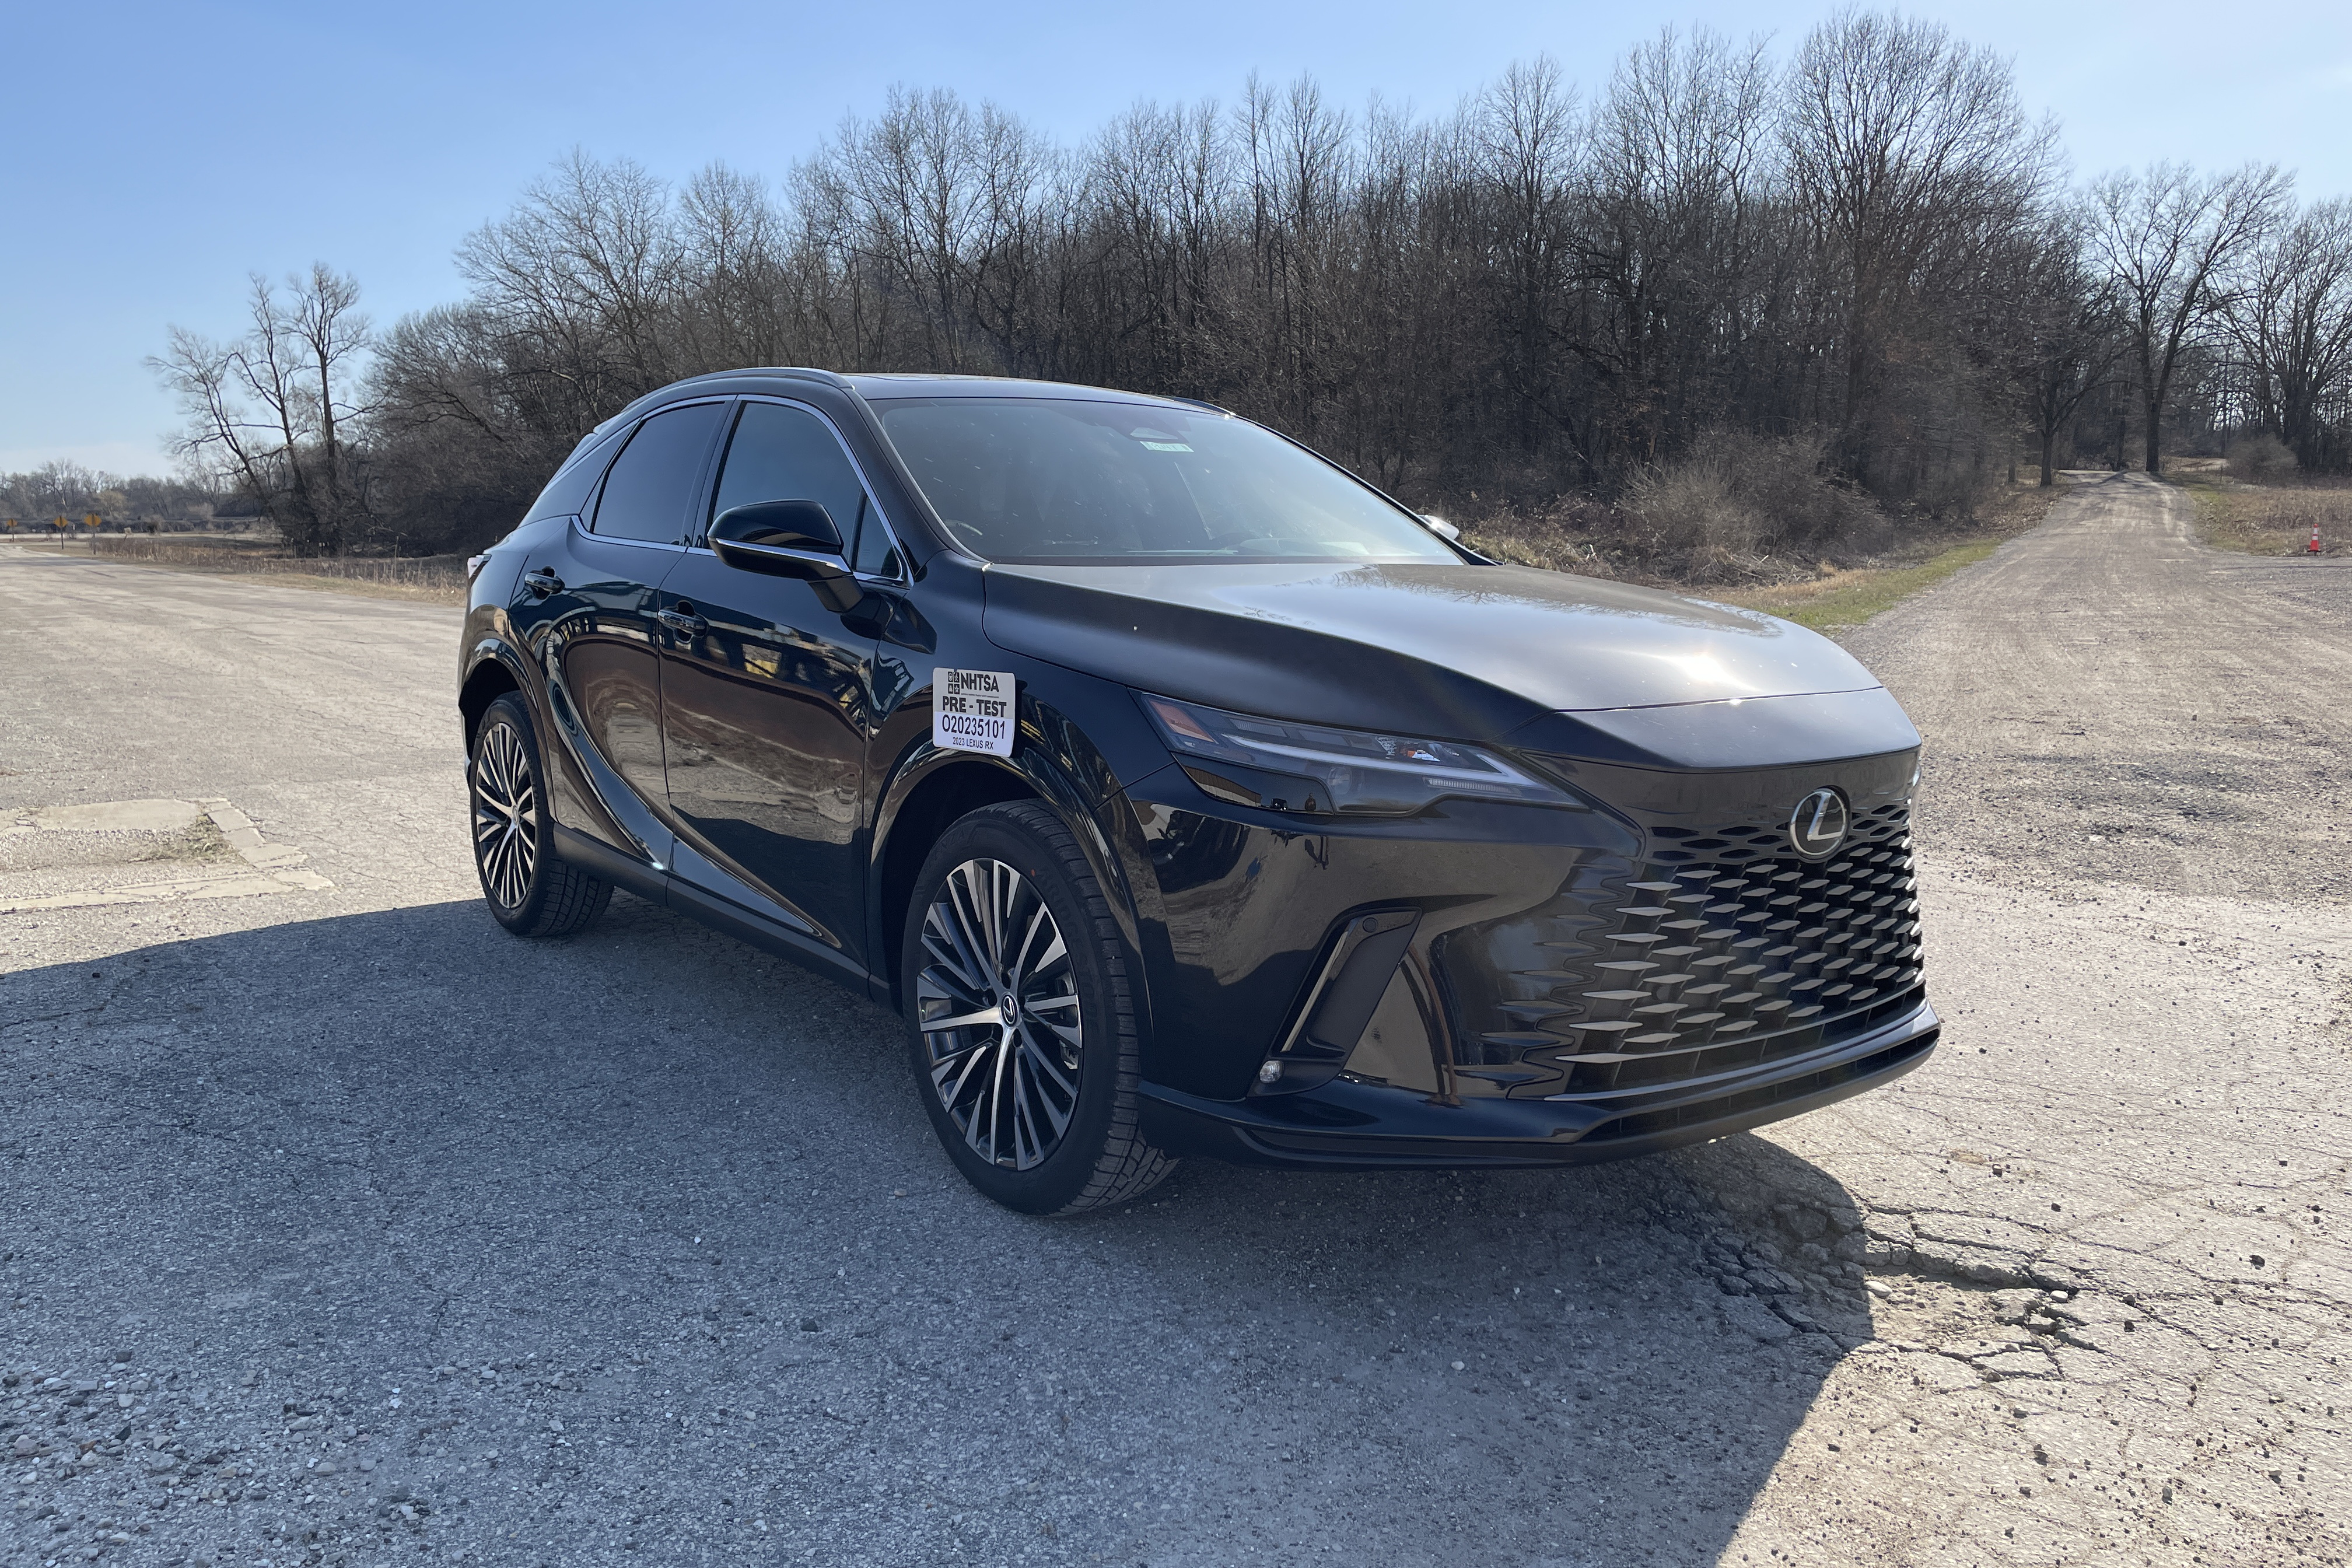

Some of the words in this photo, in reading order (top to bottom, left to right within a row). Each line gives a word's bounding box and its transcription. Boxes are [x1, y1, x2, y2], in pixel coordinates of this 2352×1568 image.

[961, 672, 999, 692] NHTSA
[942, 695, 966, 713] PRE
[976, 699, 1007, 718] TEST
[953, 737, 965, 746] 2023
[966, 738, 983, 749] LEXUS
[985, 741, 994, 750] RX
